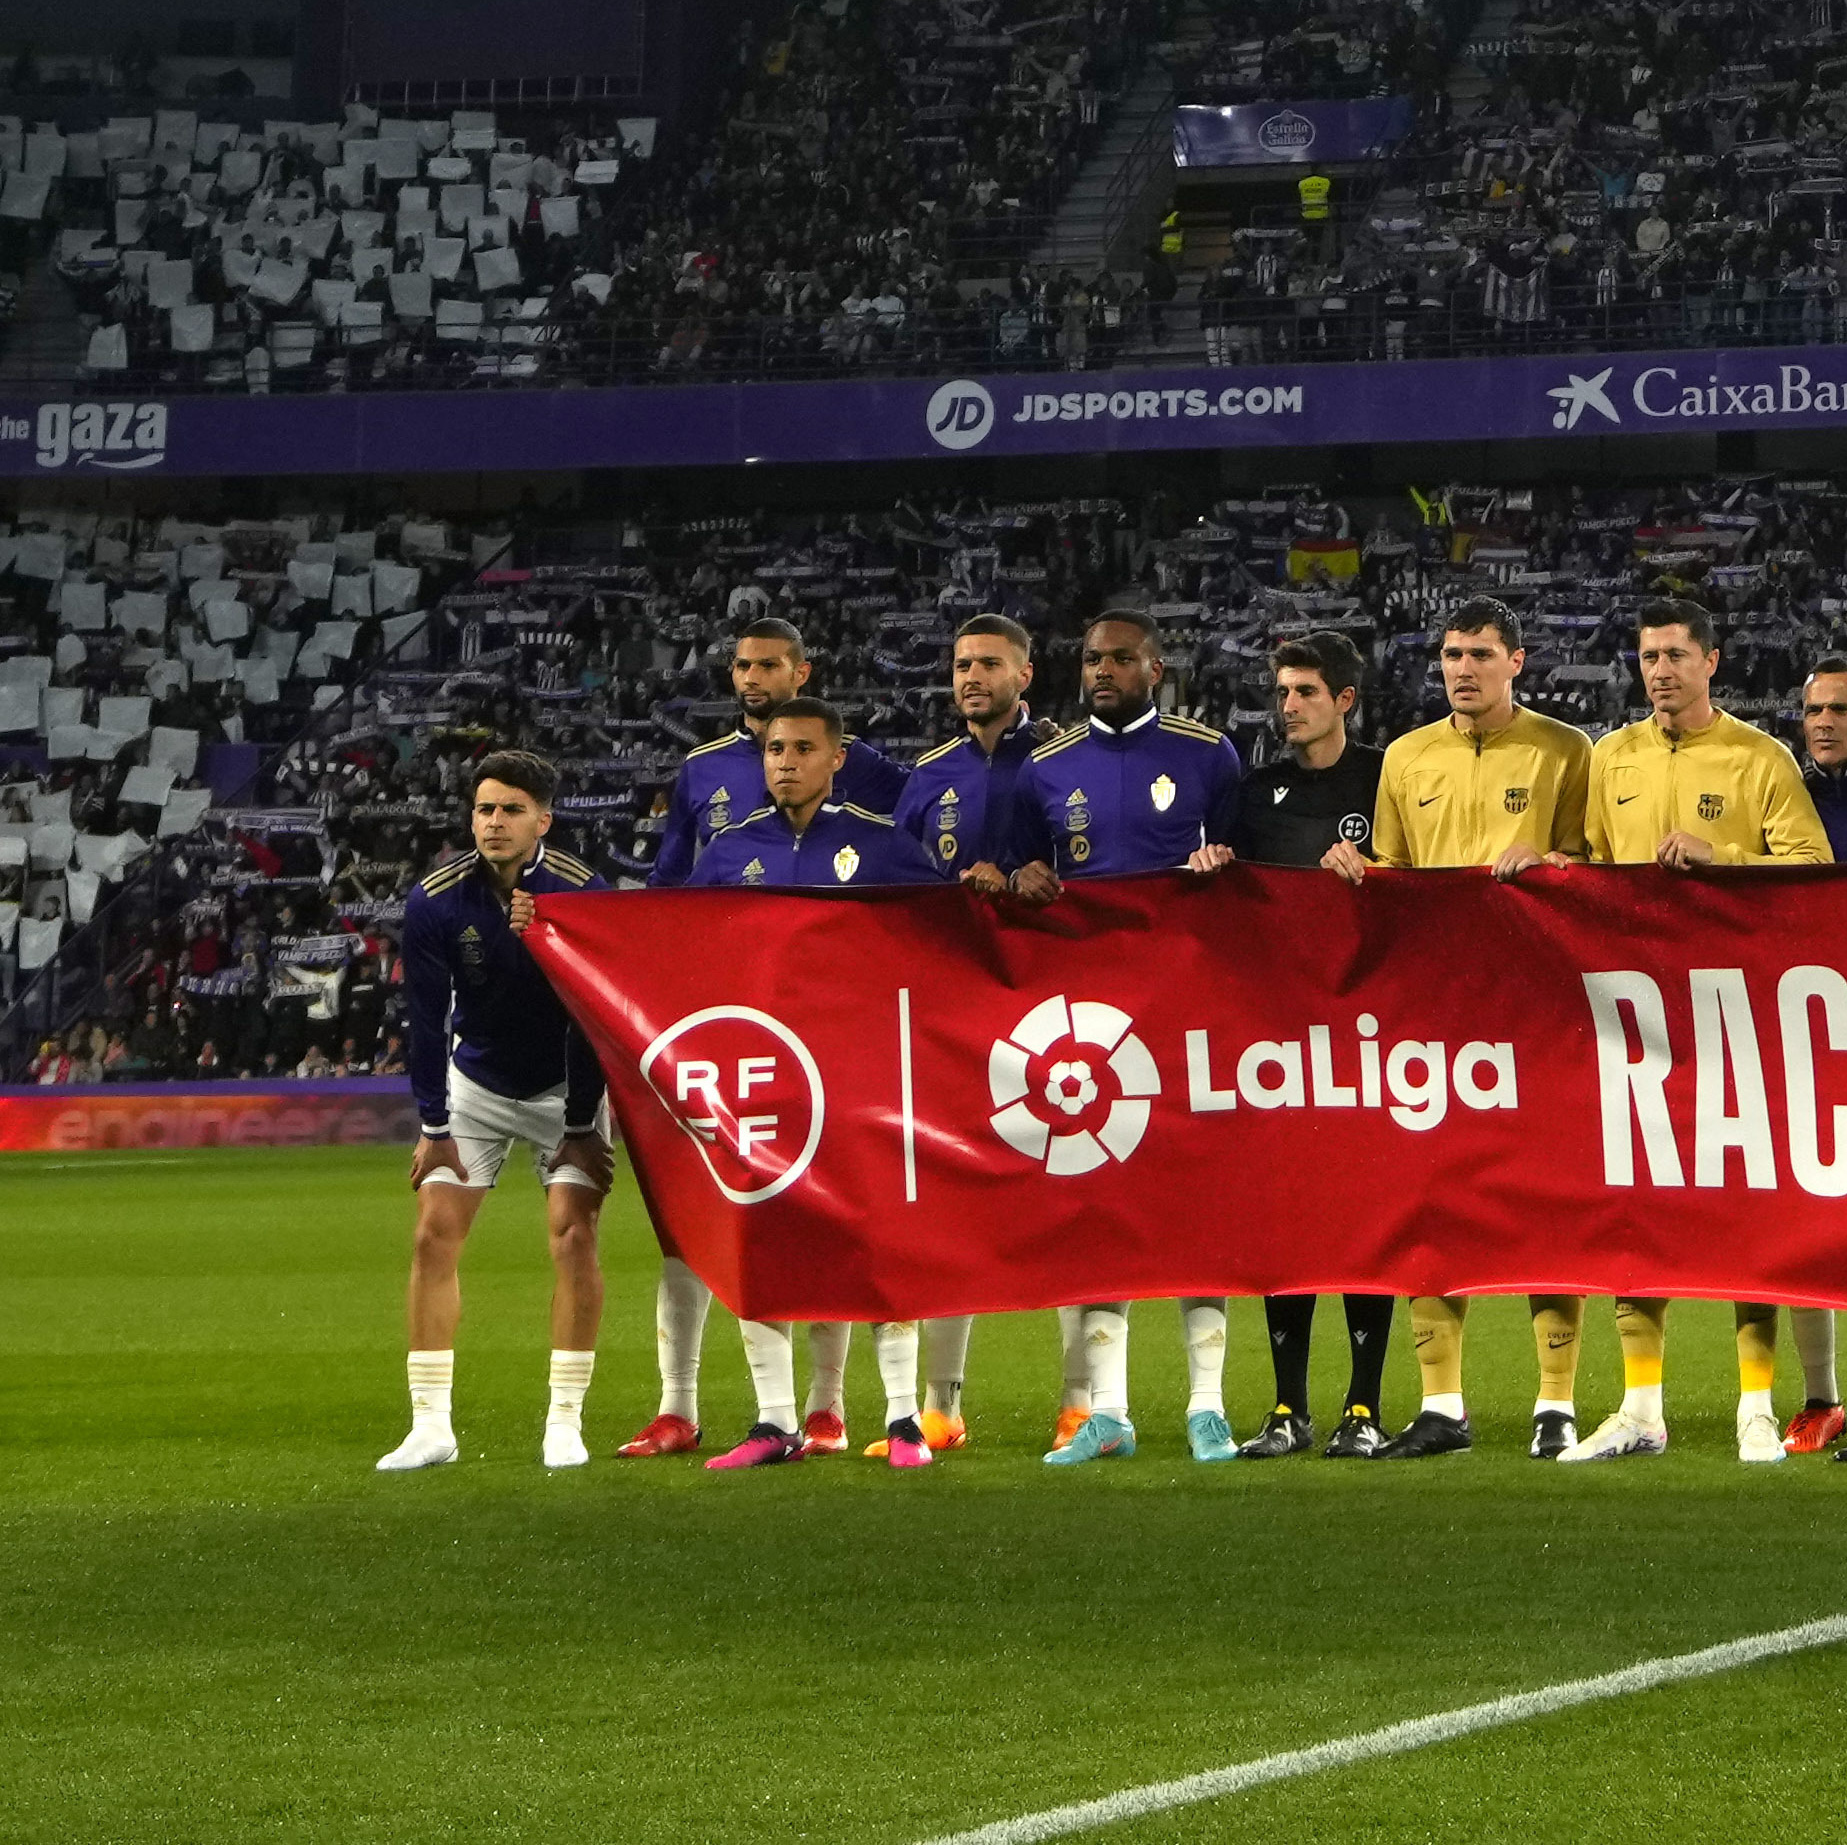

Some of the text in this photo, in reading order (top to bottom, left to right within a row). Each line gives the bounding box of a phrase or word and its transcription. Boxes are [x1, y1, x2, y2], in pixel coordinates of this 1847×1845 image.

[1266, 122, 1308, 134] Estrella
[1268, 135, 1306, 146] Galicia
[932, 385, 1303, 432] JD JDSPORTS.COM
[0, 402, 168, 468] he gaza
[1074, 841, 1087, 855] JD
[676, 1056, 777, 1102] RF
[1185, 1012, 1519, 1132] LaLiga
